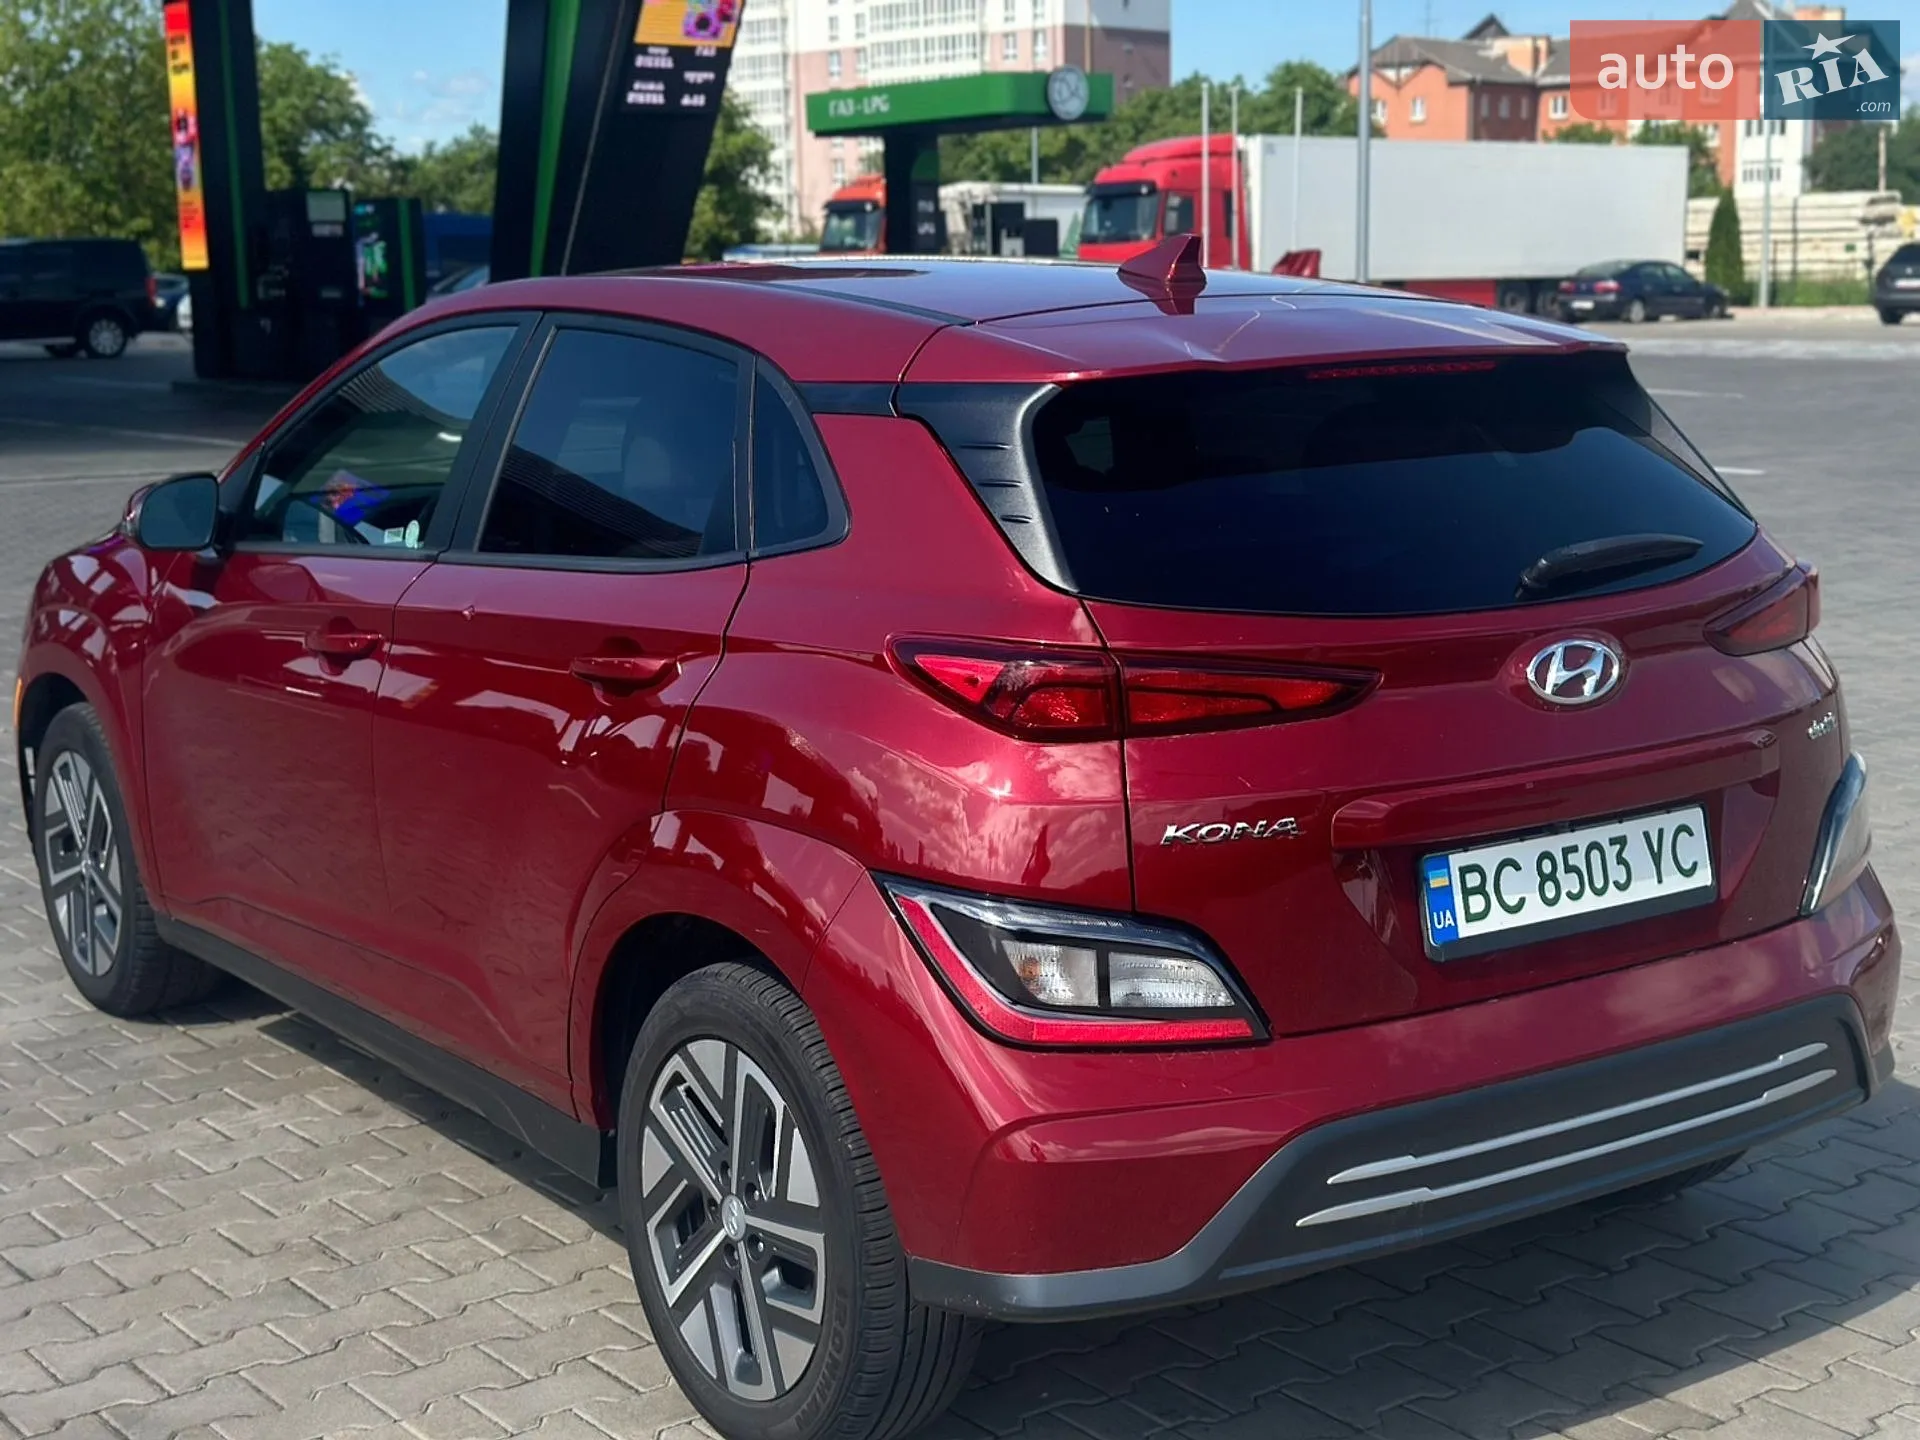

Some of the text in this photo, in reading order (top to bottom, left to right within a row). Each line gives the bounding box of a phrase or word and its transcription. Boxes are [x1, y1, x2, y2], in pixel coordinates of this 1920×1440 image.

[1160, 816, 1300, 846] KONA
[1458, 822, 1699, 925] BC 8503 YC
[1432, 909, 1456, 930] UA
